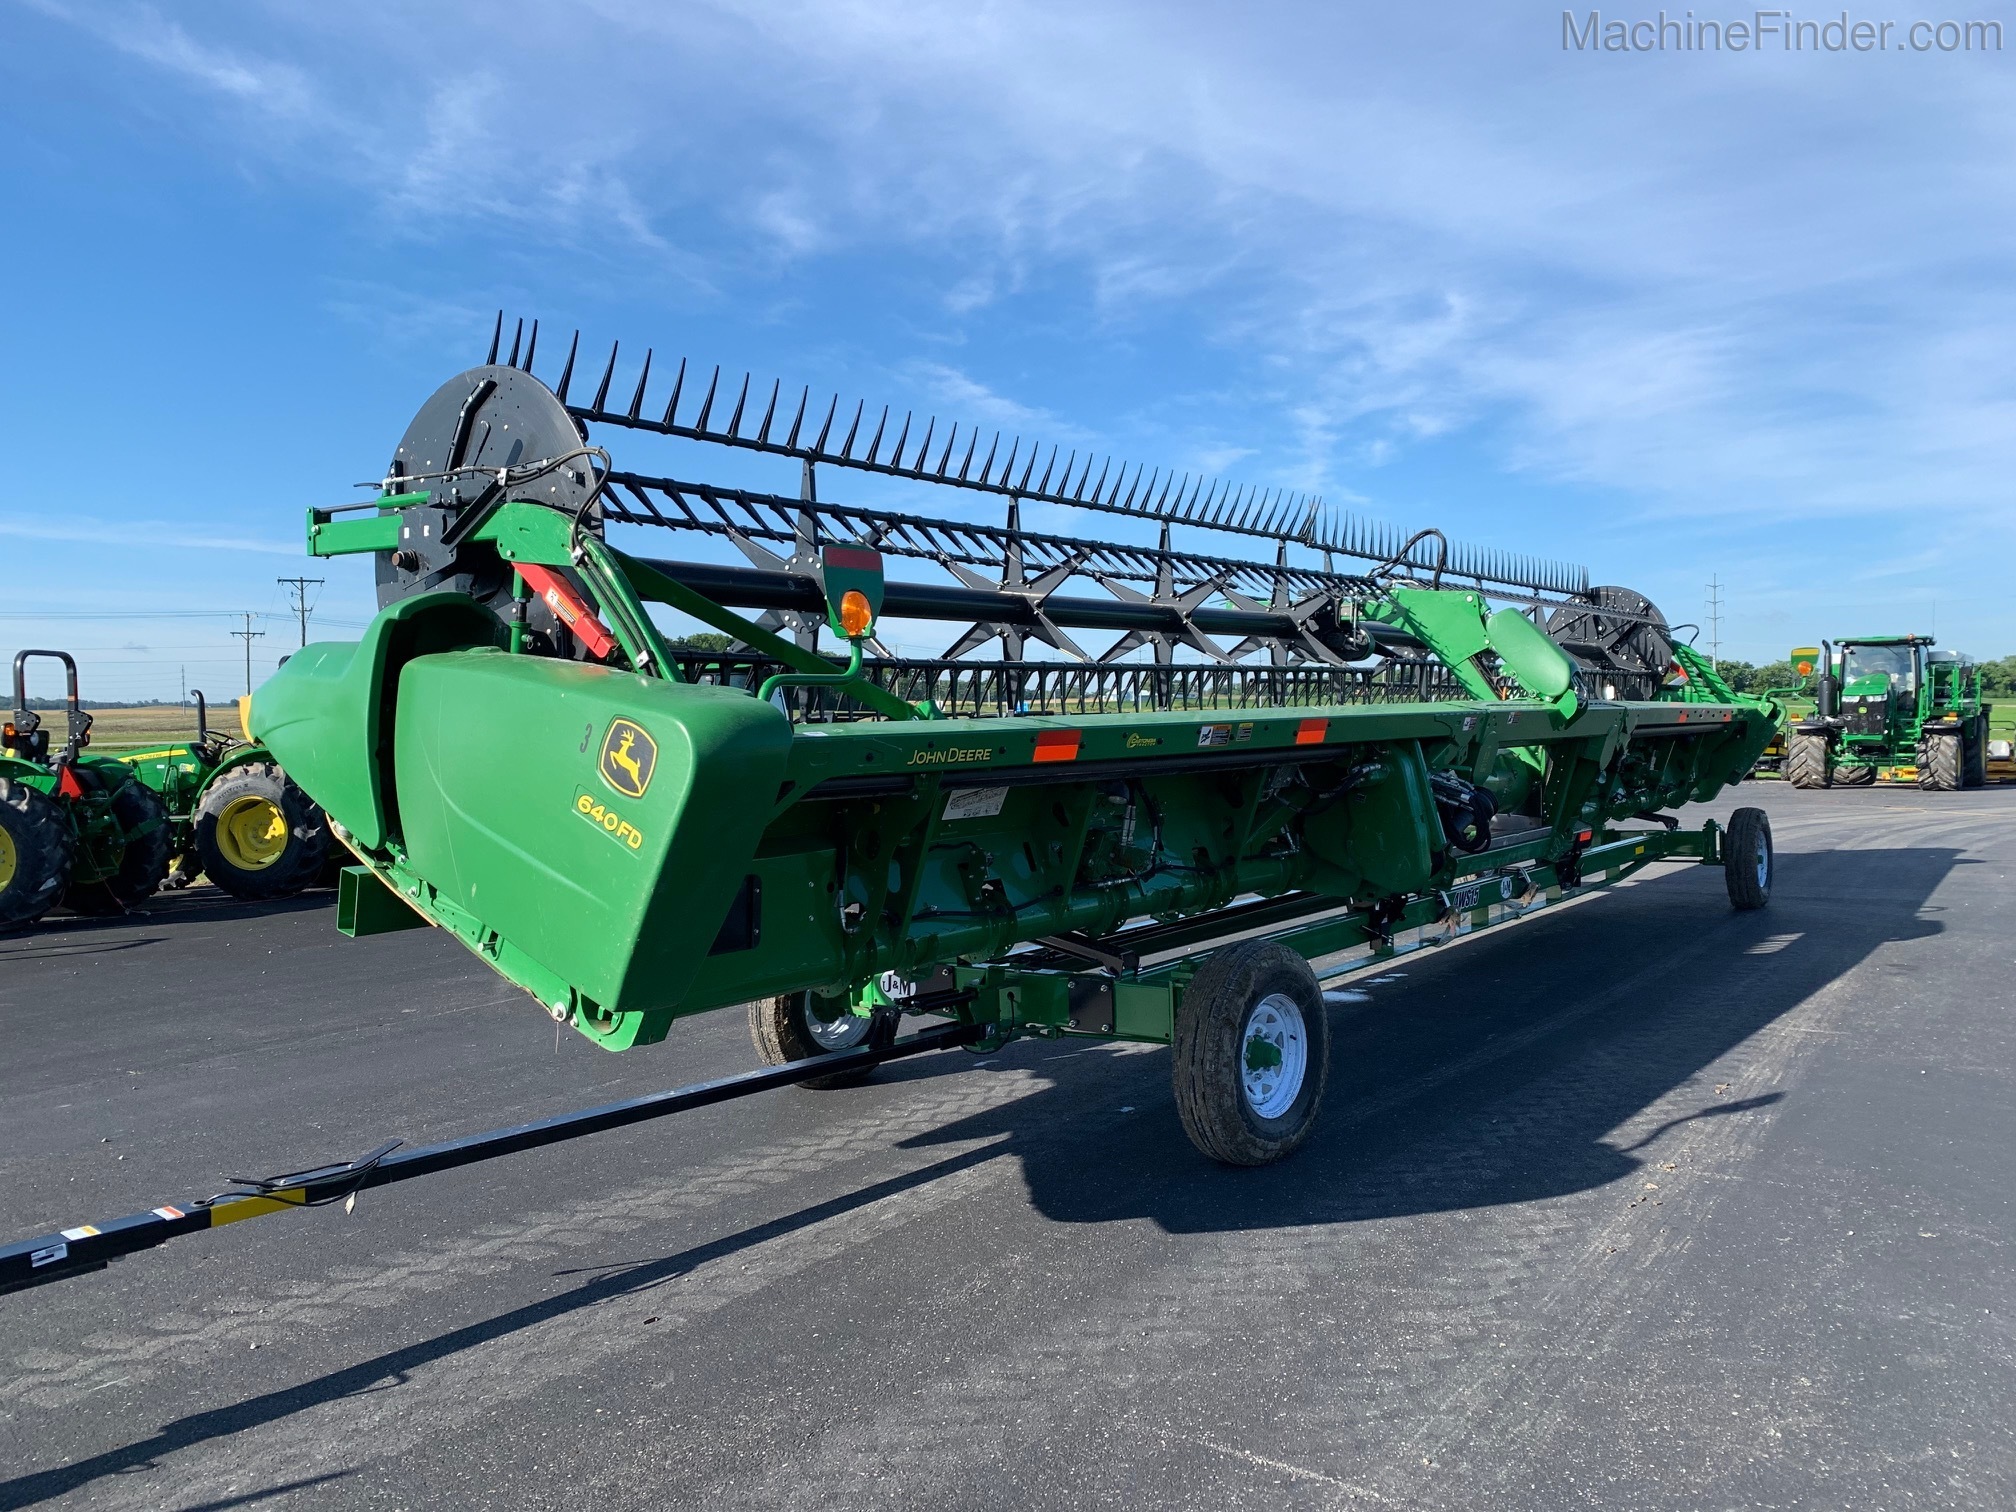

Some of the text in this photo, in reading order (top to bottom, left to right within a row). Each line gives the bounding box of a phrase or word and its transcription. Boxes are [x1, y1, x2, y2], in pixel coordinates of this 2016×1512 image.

[579, 723, 592, 754] 3
[907, 747, 992, 765] JOHN DEERE
[577, 794, 643, 850] 640FD
[882, 974, 911, 996] J&M
